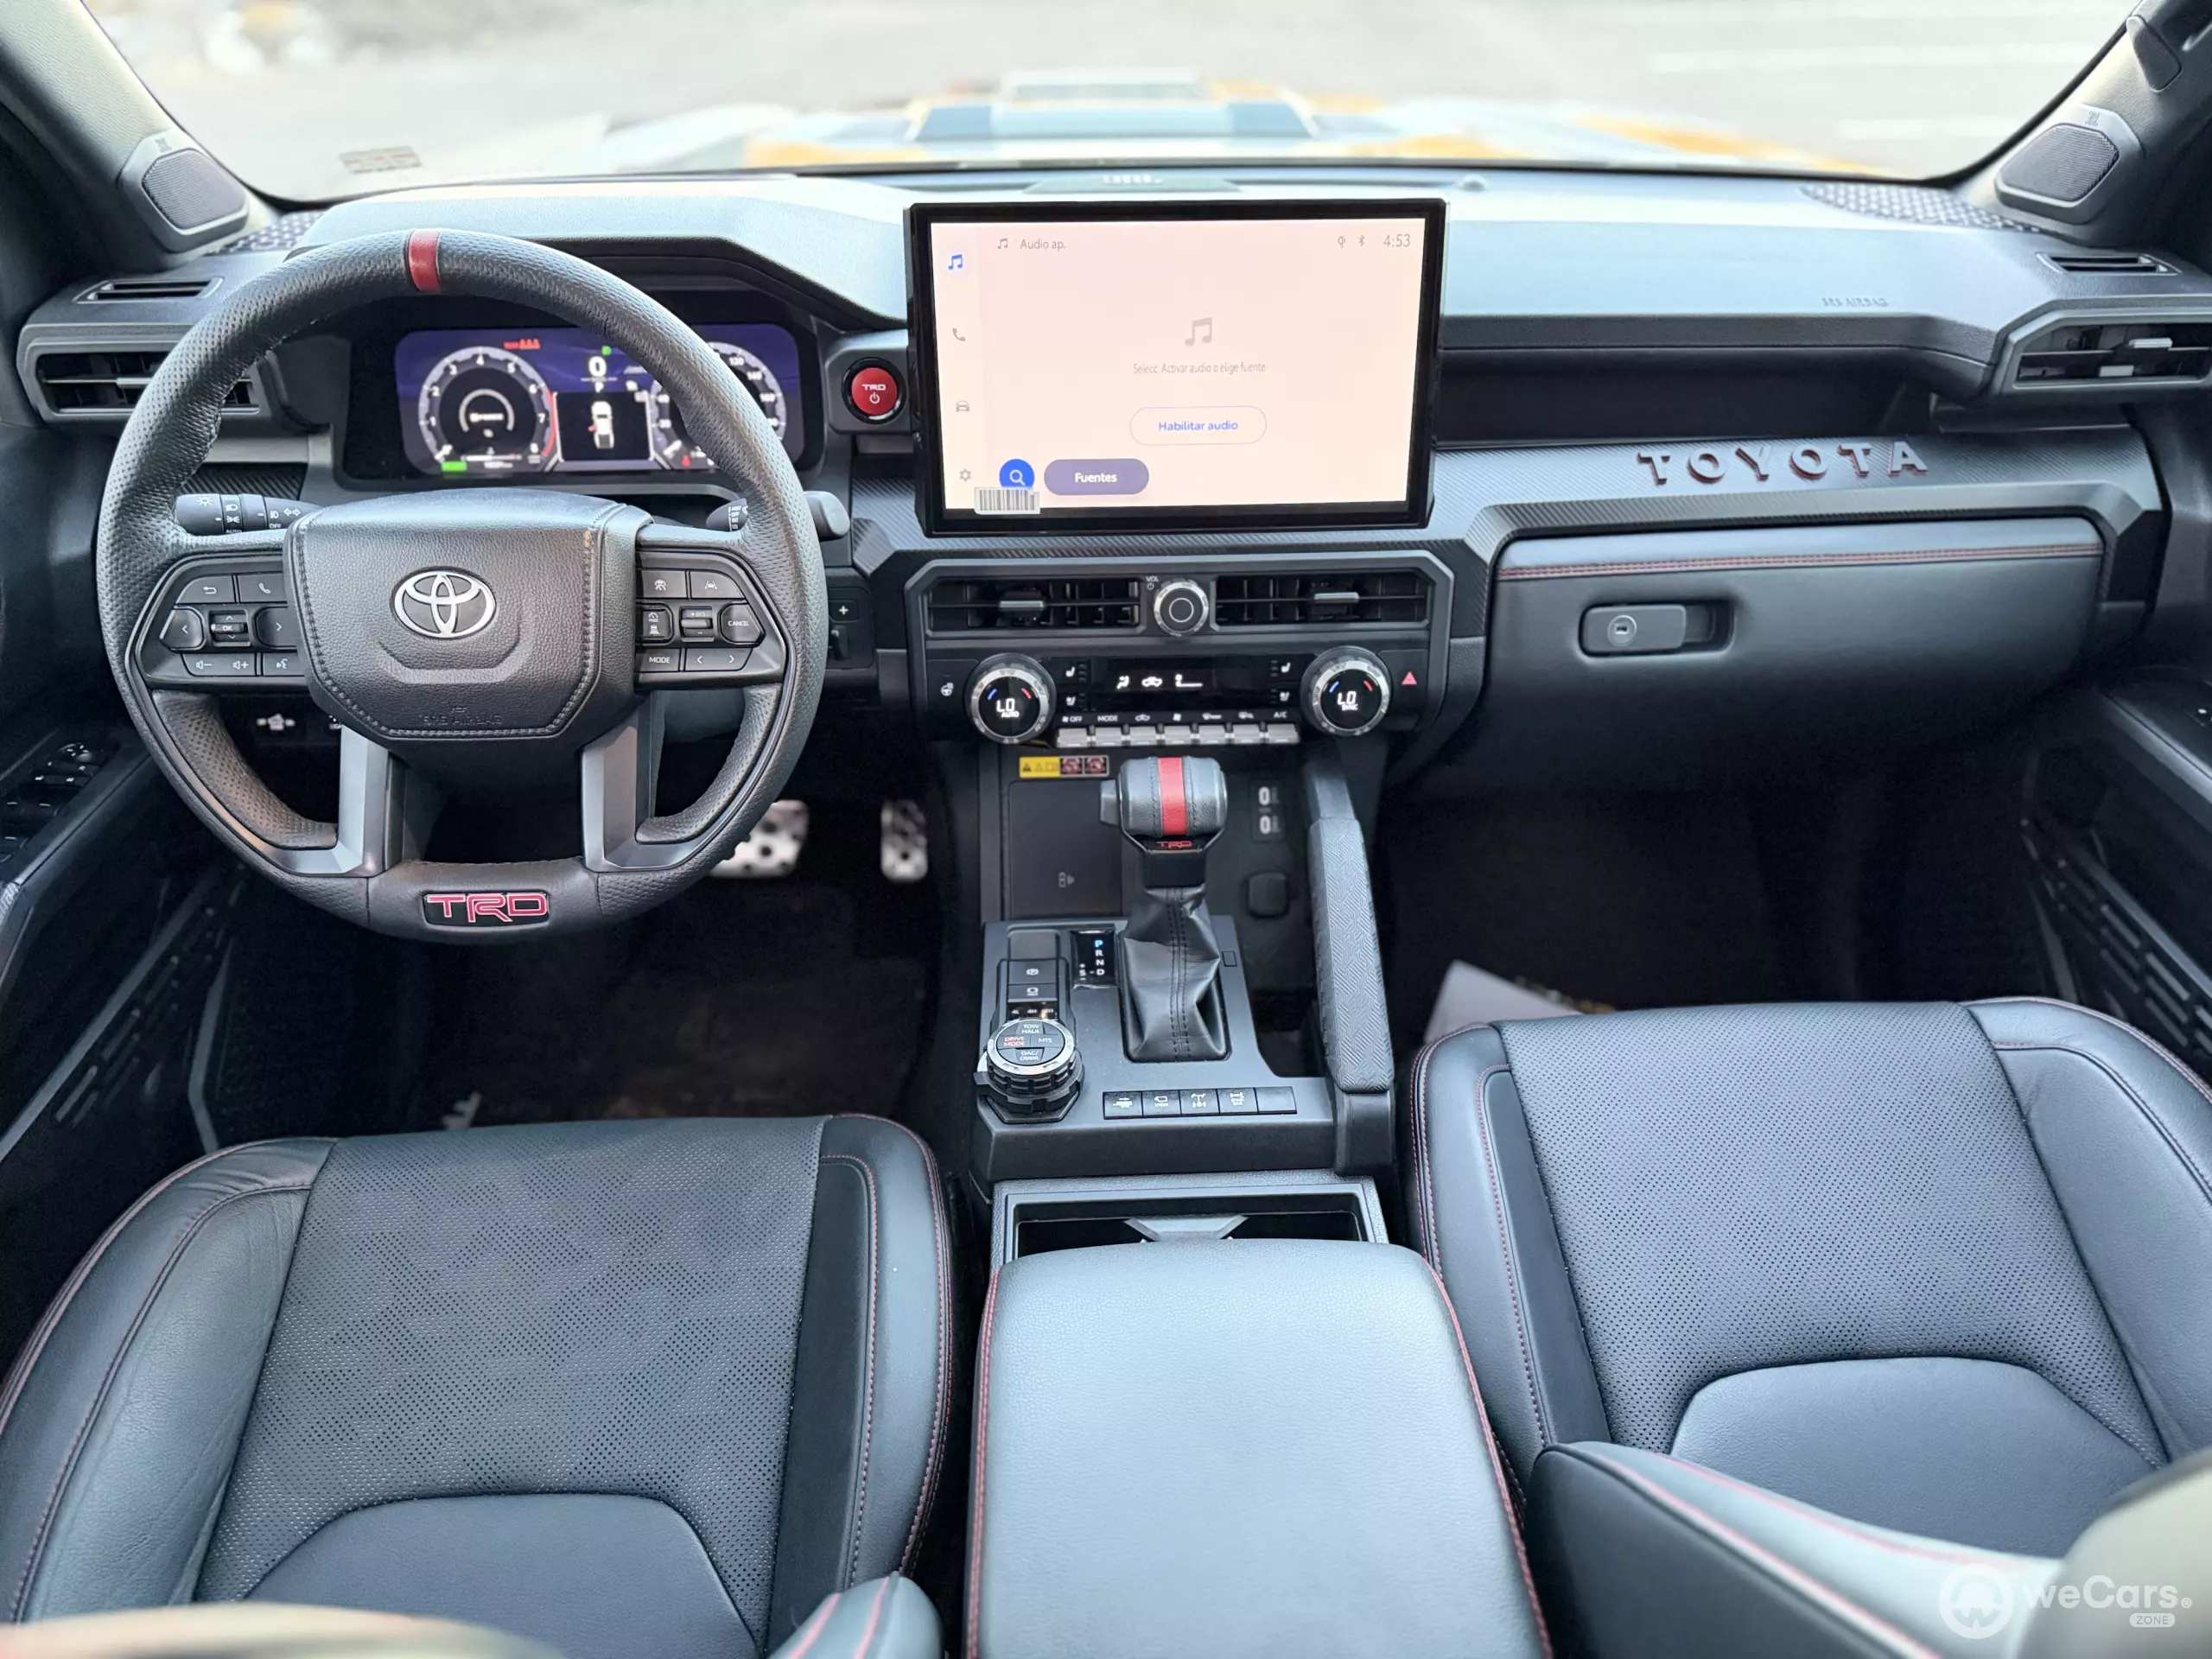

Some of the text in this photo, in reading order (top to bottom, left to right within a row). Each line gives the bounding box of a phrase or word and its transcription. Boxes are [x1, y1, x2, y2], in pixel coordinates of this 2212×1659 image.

[1020, 238, 1066, 252] Audio ap.
[1383, 233, 1410, 247] 4:53
[476, 355, 485, 366] 4
[588, 356, 607, 378] 0
[1161, 363, 1188, 373] Activar
[1189, 362, 1211, 373] audio
[1220, 362, 1239, 375] elige
[1241, 361, 1266, 372] fuente
[537, 412, 546, 423] 7
[1158, 420, 1238, 431] Habilitar audio
[1637, 441, 1929, 486] TOYOTA
[1075, 473, 1117, 483] Fuentes
[426, 893, 549, 923] TRD
